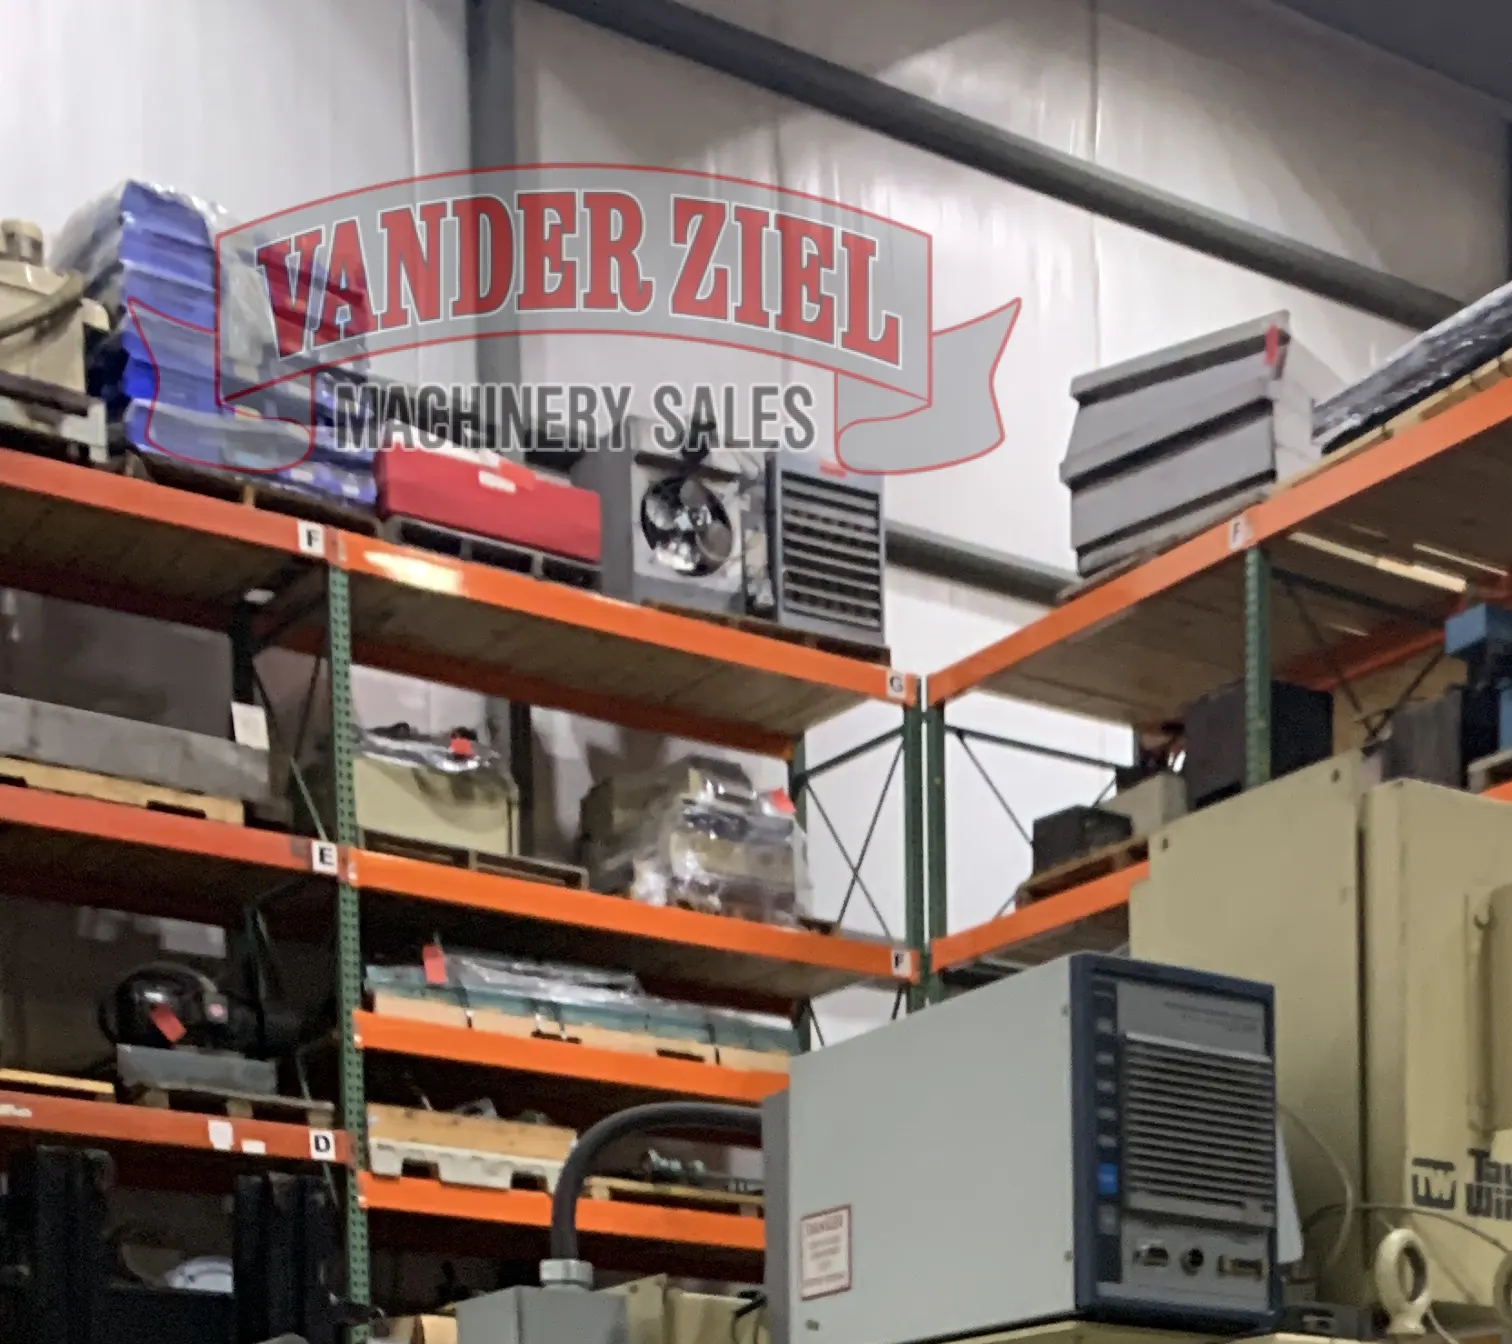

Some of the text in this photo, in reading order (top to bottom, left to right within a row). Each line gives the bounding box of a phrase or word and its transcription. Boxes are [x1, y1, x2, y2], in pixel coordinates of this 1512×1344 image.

[305, 529, 320, 547] F
[889, 675, 904, 693] G
[318, 847, 334, 866] E
[314, 1134, 331, 1153] D
